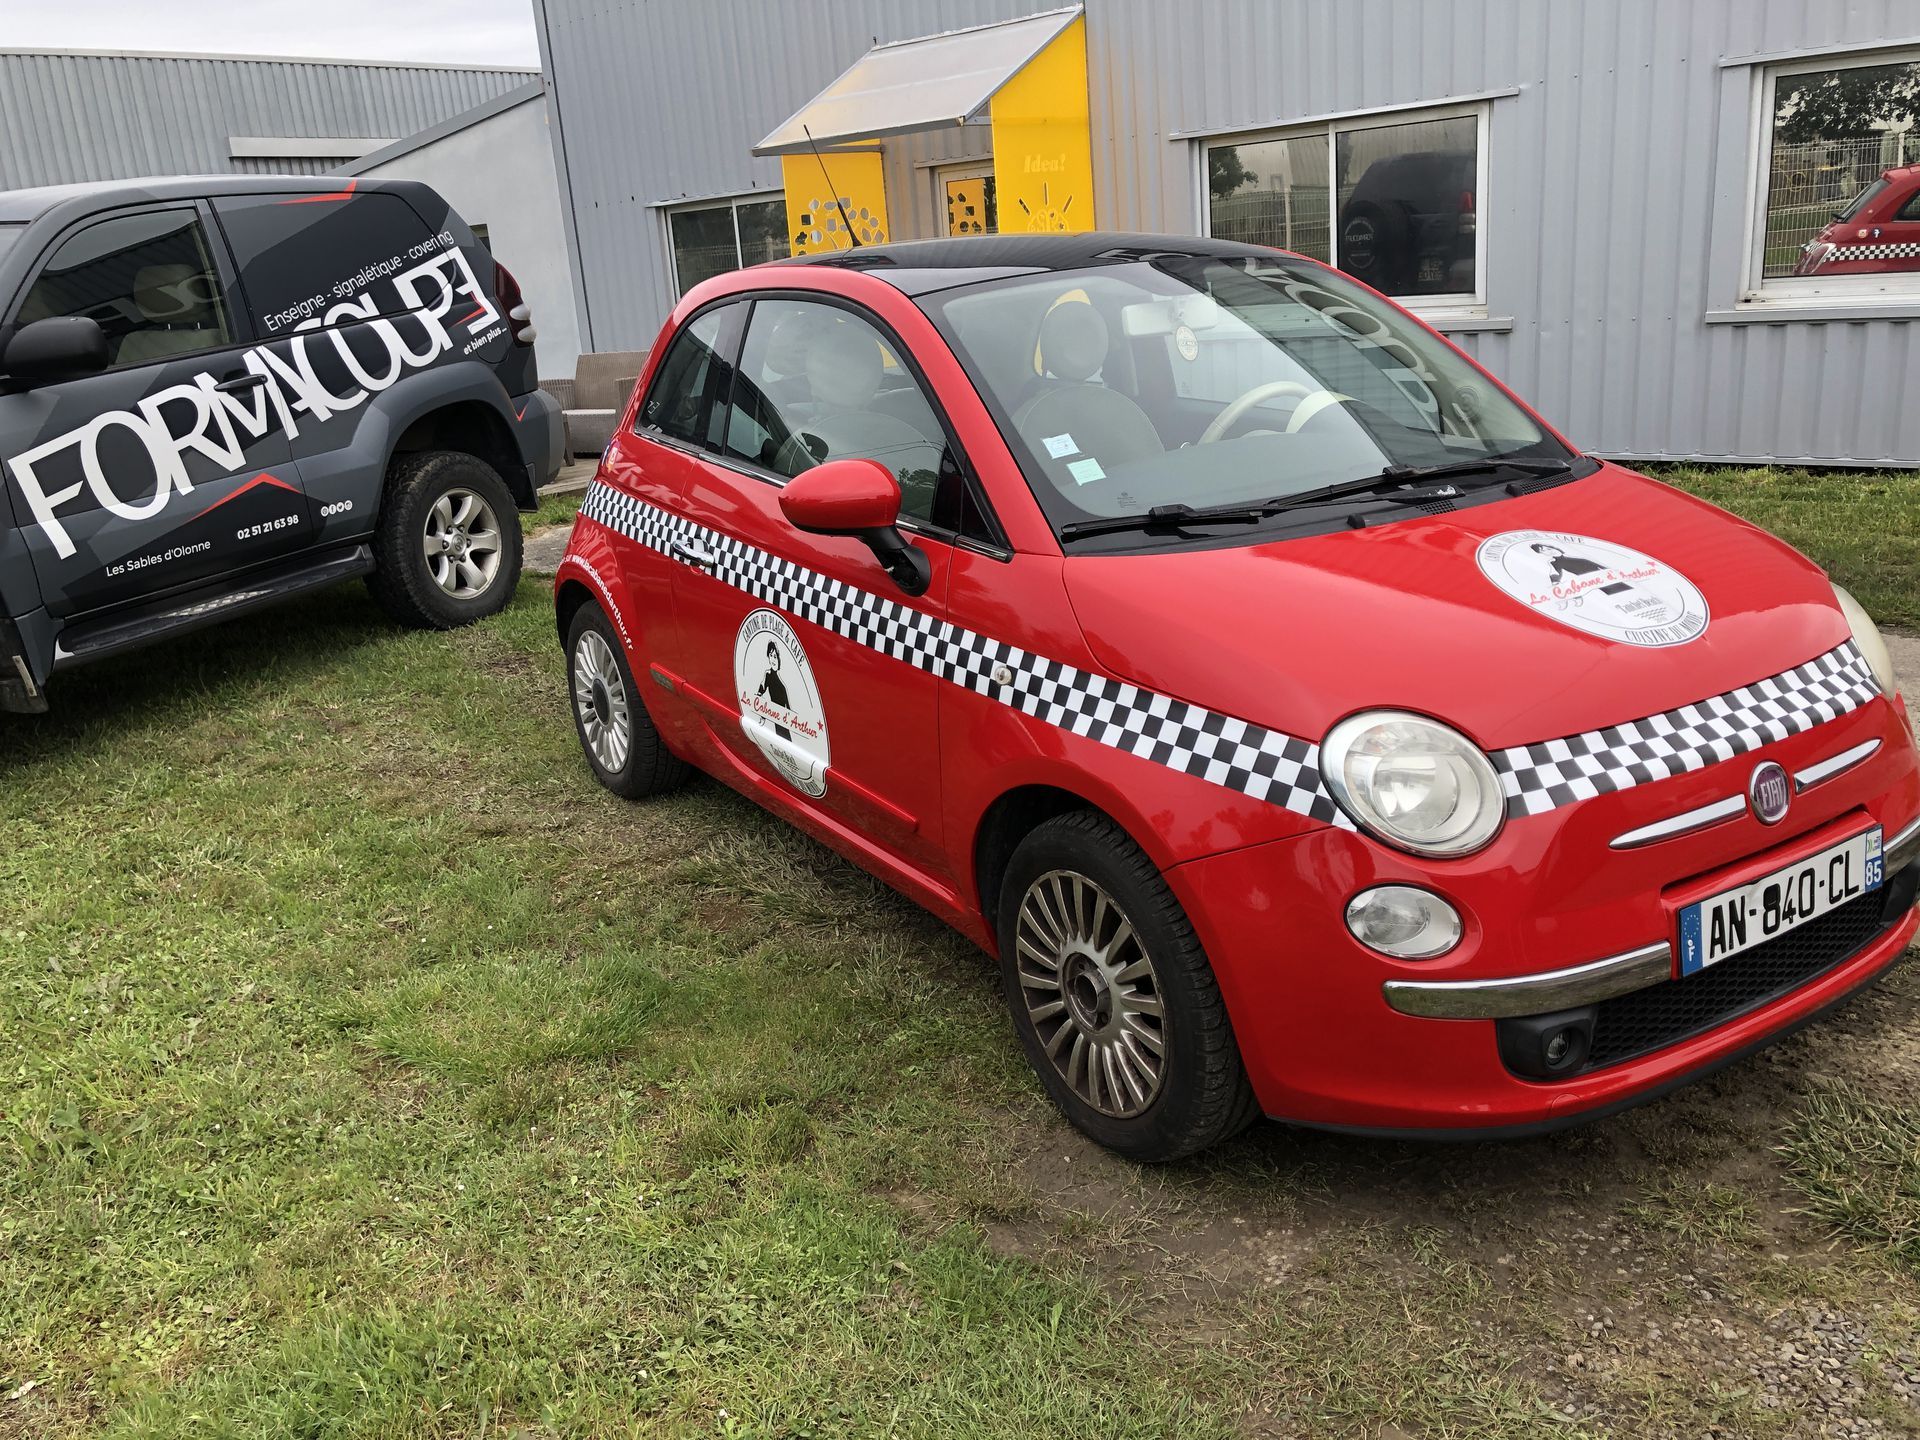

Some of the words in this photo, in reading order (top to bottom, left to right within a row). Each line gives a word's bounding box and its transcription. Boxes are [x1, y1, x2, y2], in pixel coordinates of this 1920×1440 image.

[1023, 153, 1066, 173] Idea!
[263, 292, 326, 331] Enseigne
[332, 255, 403, 298] signalétique
[408, 230, 455, 260] covering
[463, 344, 473, 355] et
[470, 336, 488, 351] bien
[237, 528, 251, 540] 02
[251, 524, 262, 536] 51
[262, 521, 273, 533] 21
[273, 517, 287, 530] 63
[287, 514, 300, 526] 98
[106, 563, 125, 578] Les
[126, 552, 163, 571] Sables
[164, 540, 211, 561] d'Olonne
[1529, 593, 1551, 606] La
[1552, 576, 1605, 599] Cabane
[1624, 628, 1674, 644] CUISINE
[740, 691, 752, 706] La
[753, 697, 781, 721] Cabane
[1760, 777, 1783, 810] FIAT
[1865, 860, 1882, 886] 85
[1709, 850, 1860, 959] AN-840-CL
